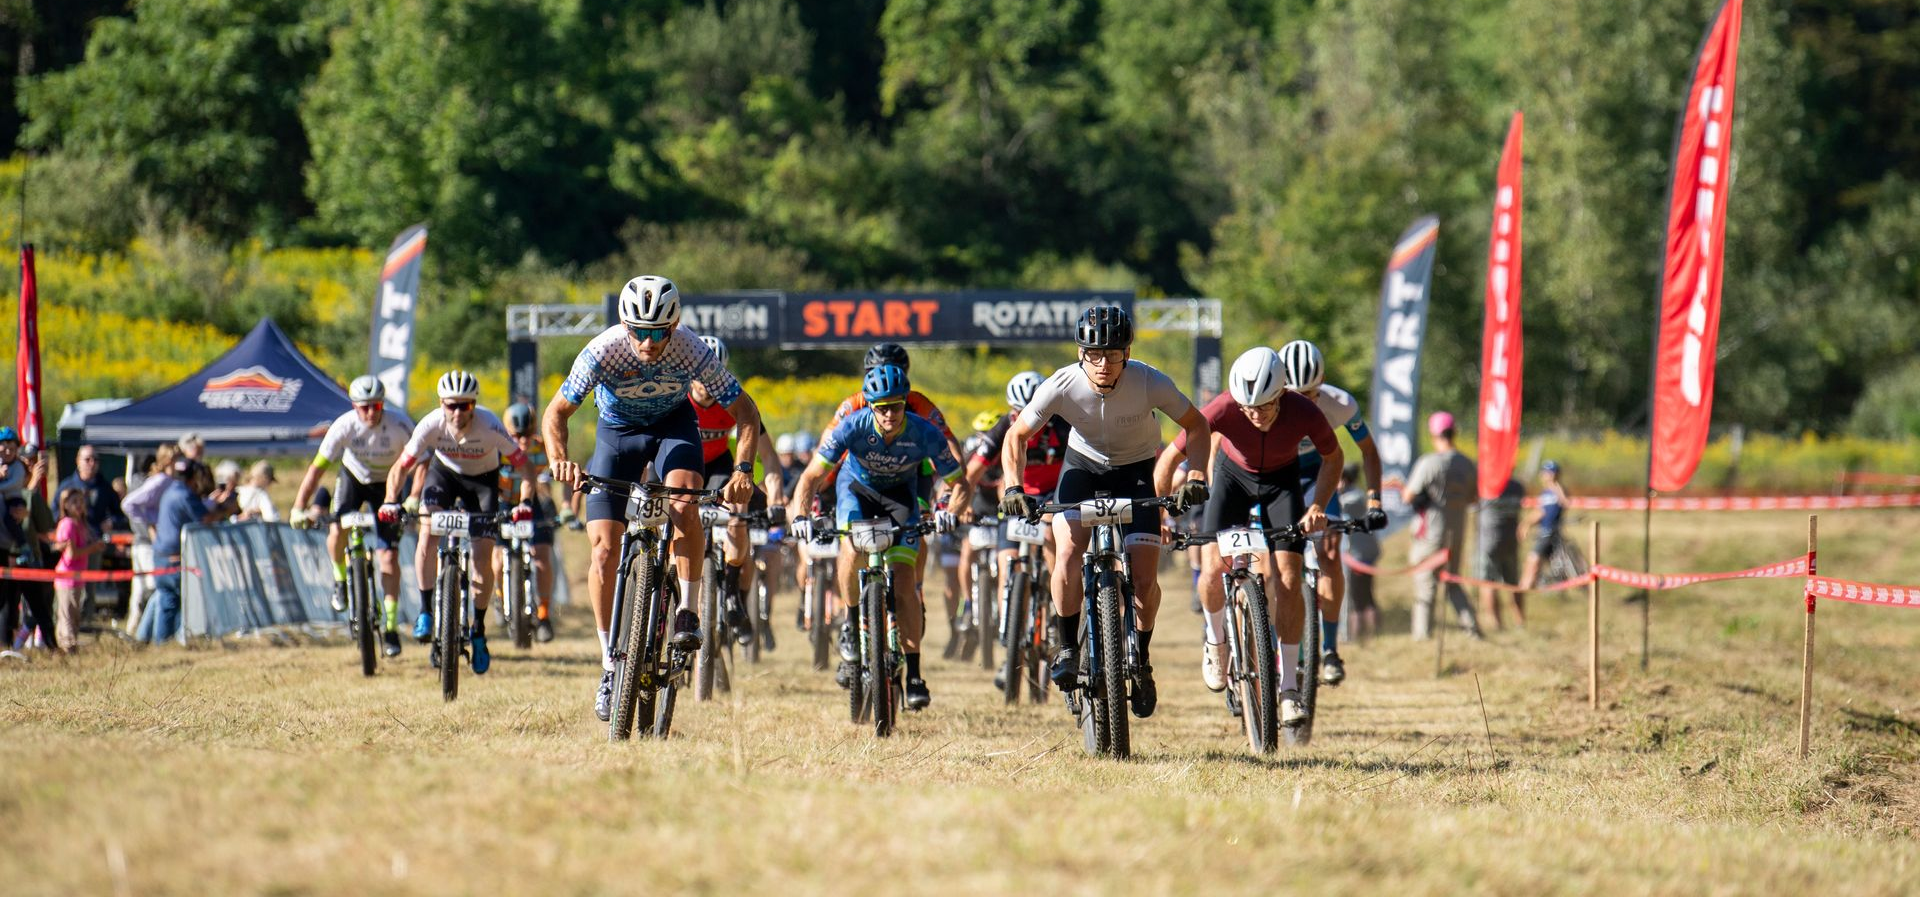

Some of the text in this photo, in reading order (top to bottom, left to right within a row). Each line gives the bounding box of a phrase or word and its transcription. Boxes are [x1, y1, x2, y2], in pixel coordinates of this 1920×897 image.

[681, 301, 768, 330] ATION
[803, 301, 939, 336] START
[973, 300, 1121, 336] ROTATI
[379, 280, 412, 407] ART
[1378, 271, 1424, 465] START
[437, 514, 464, 530] 206
[1095, 498, 1118, 517] 92
[1014, 521, 1040, 538] 205
[1231, 532, 1252, 548] 21
